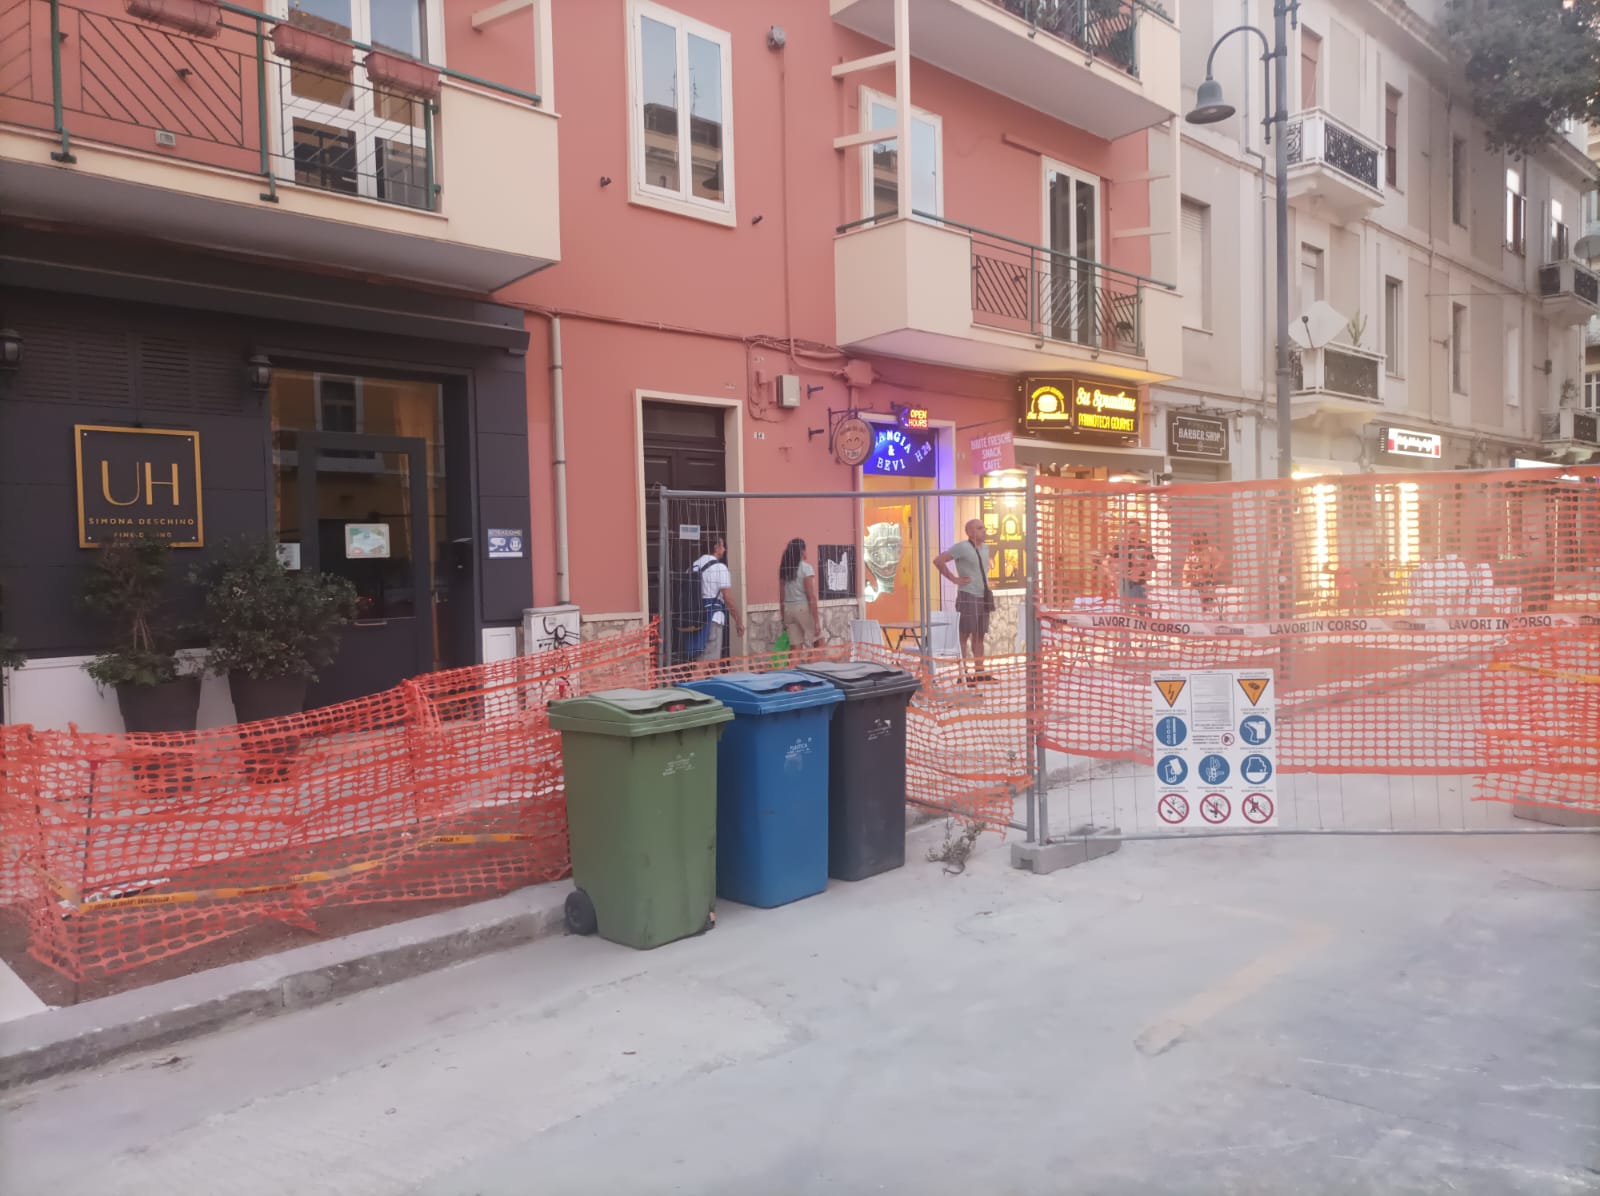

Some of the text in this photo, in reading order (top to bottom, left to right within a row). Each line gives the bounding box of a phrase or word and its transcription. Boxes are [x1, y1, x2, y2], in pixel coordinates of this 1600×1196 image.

[1179, 428, 1220, 442] BARBER SHOP
[877, 457, 906, 471] BEVI
[101, 460, 179, 506] UH
[88, 517, 194, 526] SIMONA DESCHINO
[1092, 616, 1191, 635] LAVORI IN CORSO
[1269, 619, 1368, 635] LAVORI IN CORSO
[1449, 619, 1492, 630] LAVORI
[1495, 618, 1509, 630] IN
